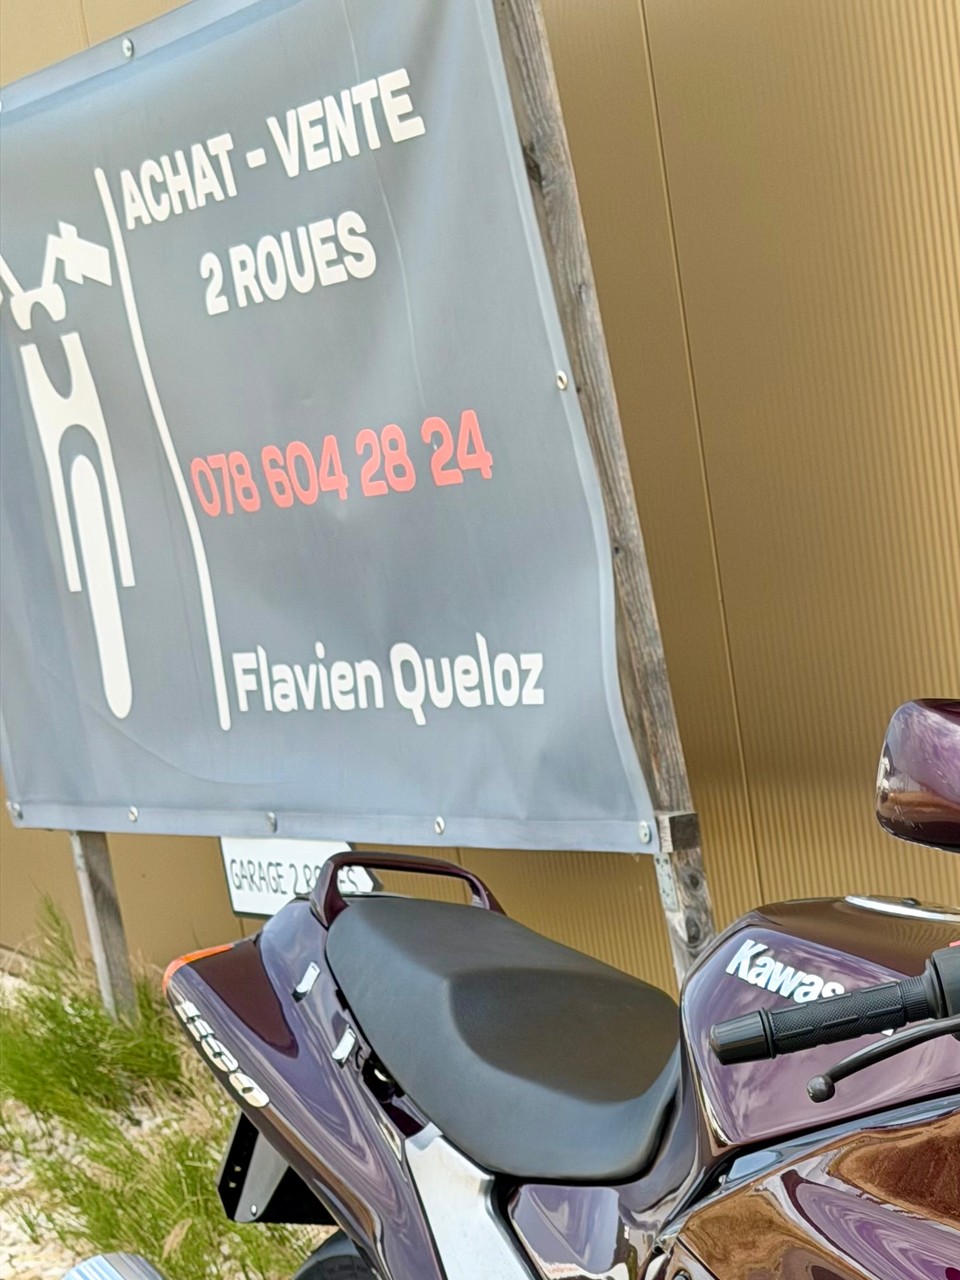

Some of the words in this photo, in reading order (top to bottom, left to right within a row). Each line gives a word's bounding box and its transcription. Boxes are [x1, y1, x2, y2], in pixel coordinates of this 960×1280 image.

[120, 132, 239, 230] ACHAT
[266, 67, 426, 178] VENTE
[199, 252, 230, 316] 2
[228, 210, 377, 308] ROUES
[189, 451, 261, 518] 078
[260, 434, 349, 509] 604
[354, 423, 417, 497] 28
[419, 409, 494, 487] 24
[232, 641, 384, 713] Flavien
[390, 632, 545, 726] Queloz
[229, 858, 288, 896] GARAGE
[289, 863, 304, 896] 2
[725, 938, 848, 1004] Kawas
